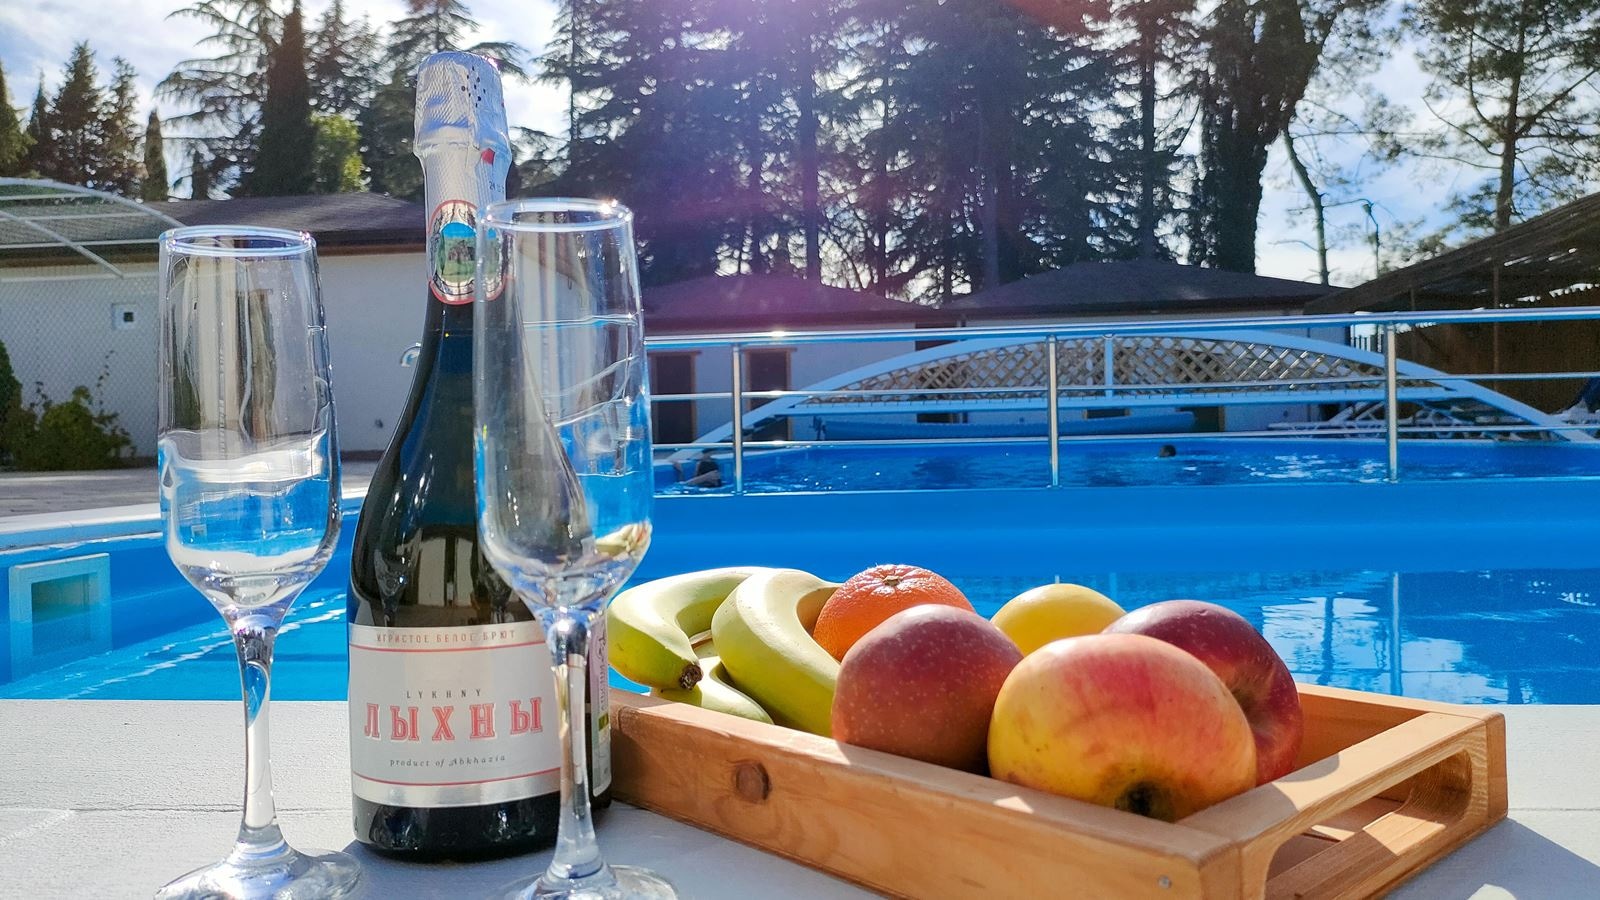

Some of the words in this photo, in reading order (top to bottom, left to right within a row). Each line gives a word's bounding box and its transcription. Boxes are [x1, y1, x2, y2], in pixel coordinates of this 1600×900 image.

[376, 632, 430, 643] ИГРИСТОЕ
[436, 633, 474, 643] БЕЛОЕ
[483, 630, 516, 641] БРЮТ
[406, 688, 482, 699] LYKHNY
[364, 697, 544, 742] ЛЫХНЫ
[389, 758, 430, 768] product
[435, 758, 445, 767] of
[448, 755, 506, 767] Abkhazia
